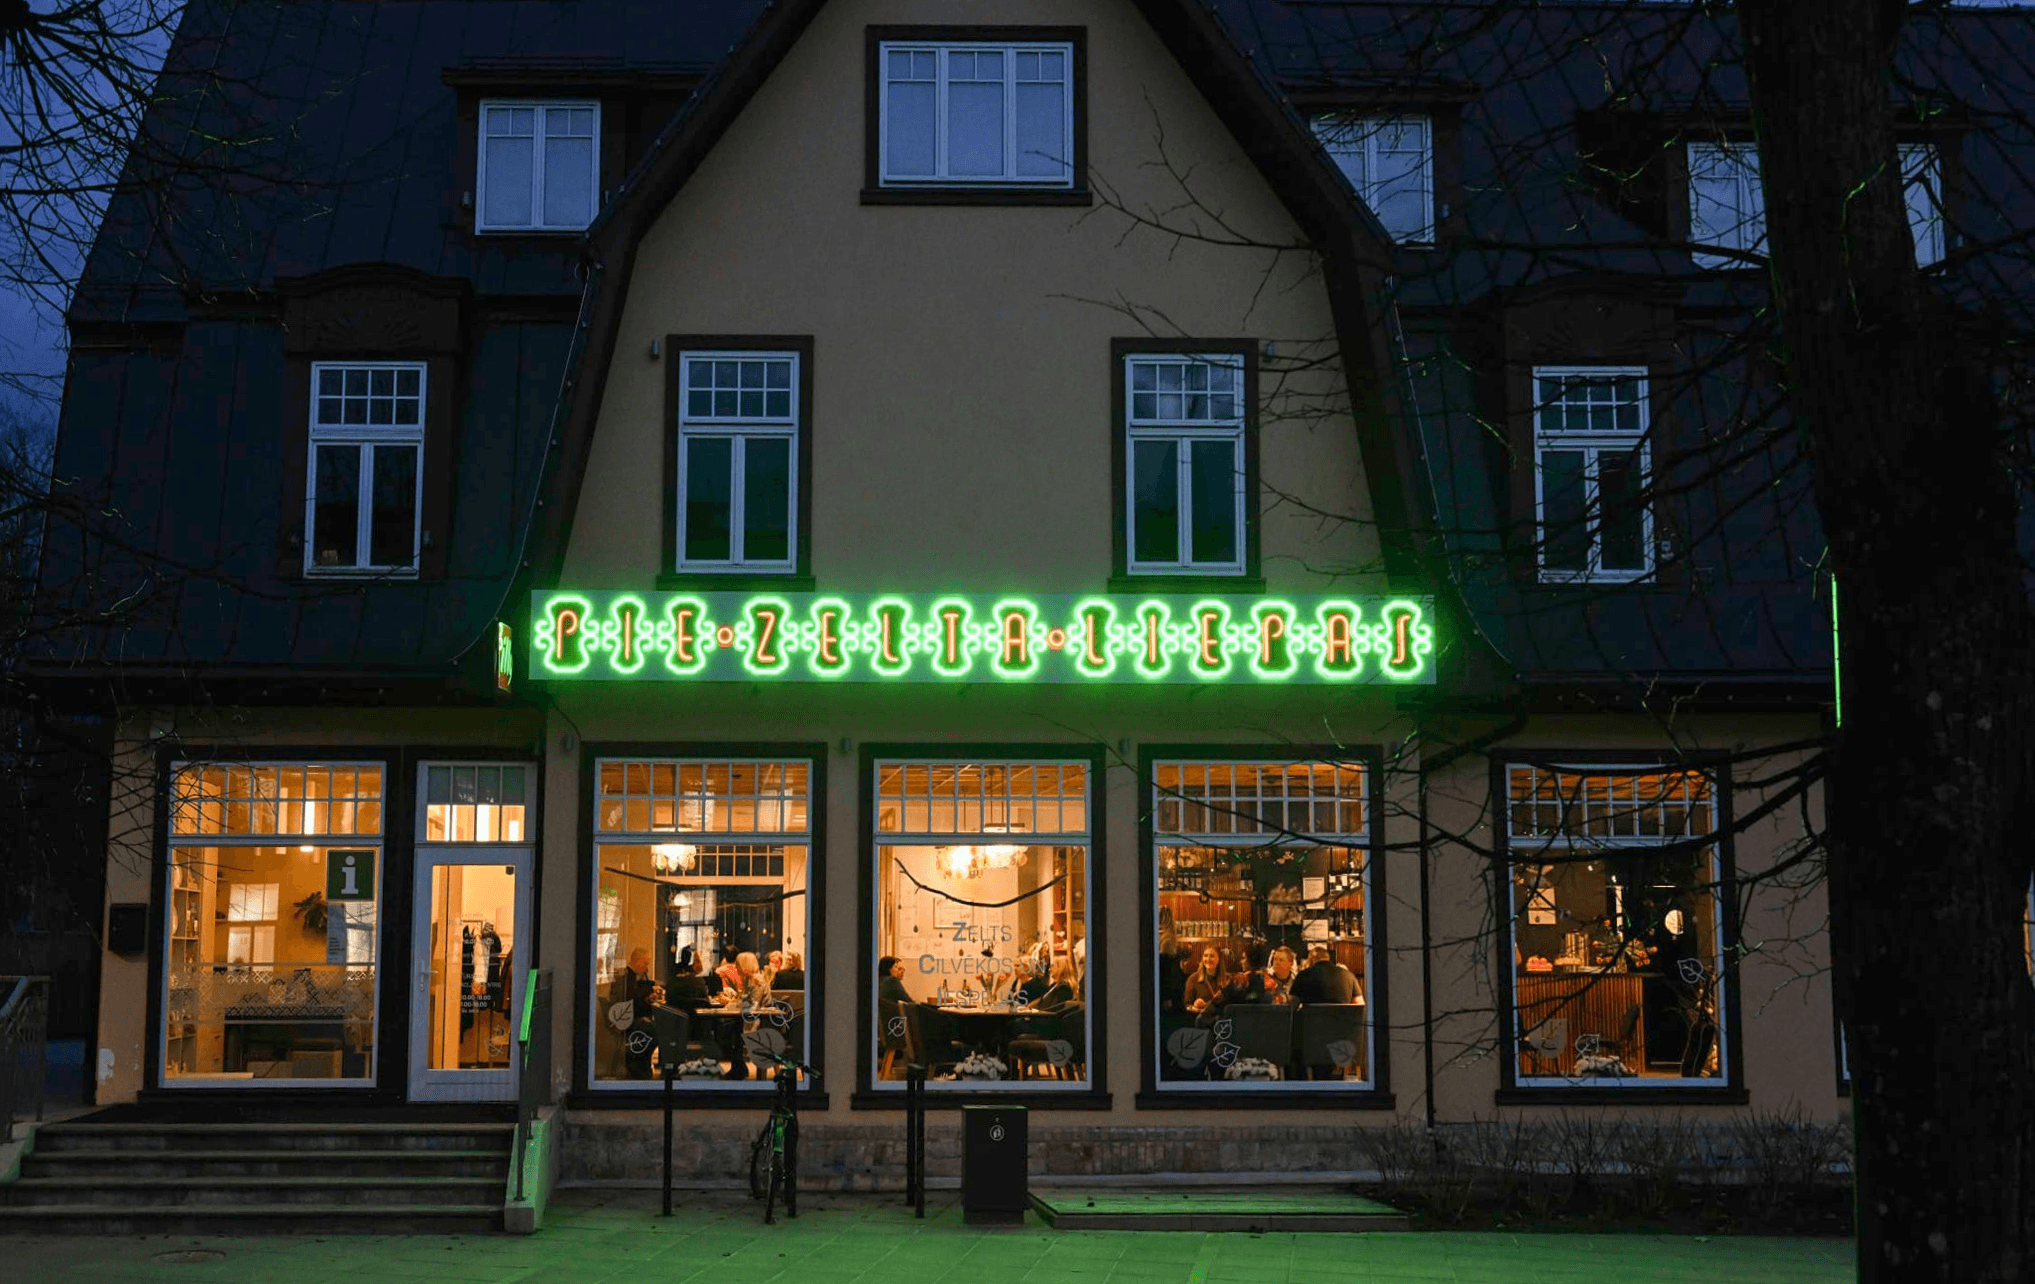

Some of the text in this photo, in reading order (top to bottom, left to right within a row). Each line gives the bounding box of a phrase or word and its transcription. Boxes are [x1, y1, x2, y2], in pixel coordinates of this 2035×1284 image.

[552, 607, 1413, 666] PIE ZELTA LIEPAS
[952, 921, 1012, 942] ZELTS
[1021, 957, 1045, 975] UN
